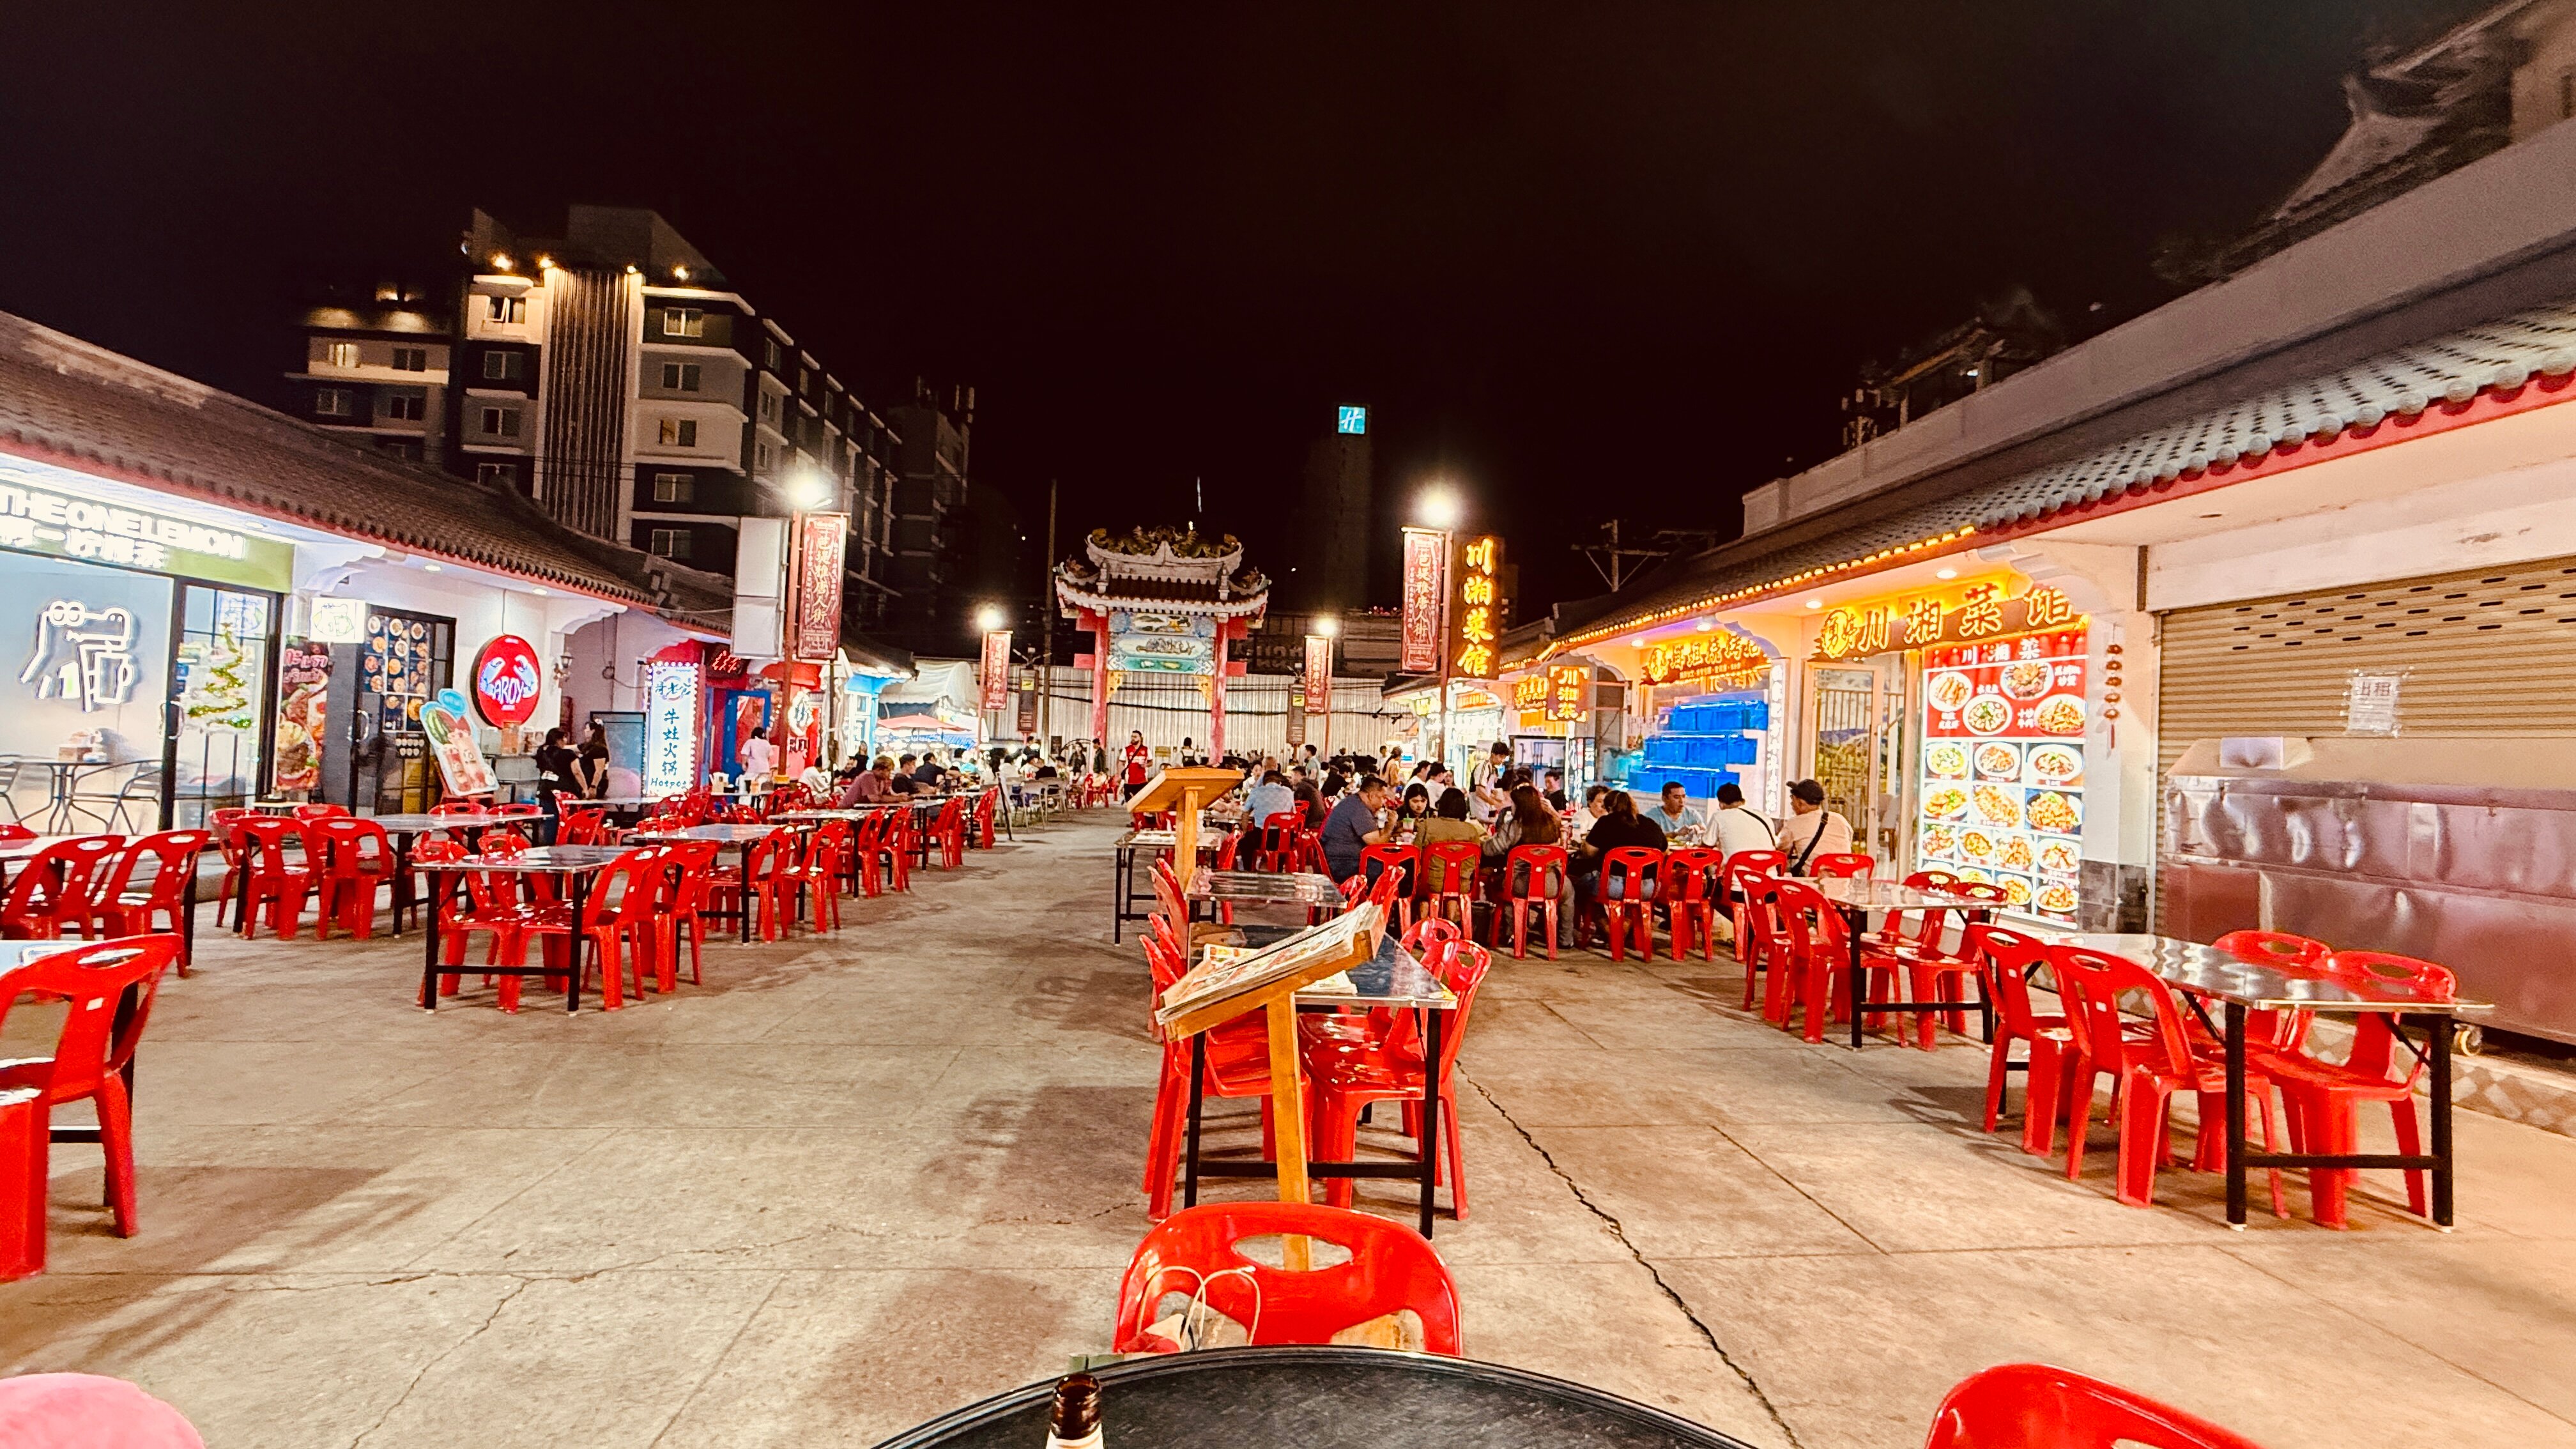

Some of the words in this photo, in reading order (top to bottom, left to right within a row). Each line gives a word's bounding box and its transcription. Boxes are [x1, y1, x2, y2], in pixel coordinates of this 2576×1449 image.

[66, 502, 141, 540] ONE
[140, 515, 245, 560] LEMON
[1457, 537, 1495, 677] 川湘菜馆
[1857, 582, 2074, 652] 川湘菜馆
[1961, 637, 2041, 665] 川湘菜
[492, 675, 525, 705] AROY
[1556, 668, 1579, 719] 川湘菜
[2356, 681, 2391, 696] 出租
[661, 708, 680, 776] 牛蛙火锅
